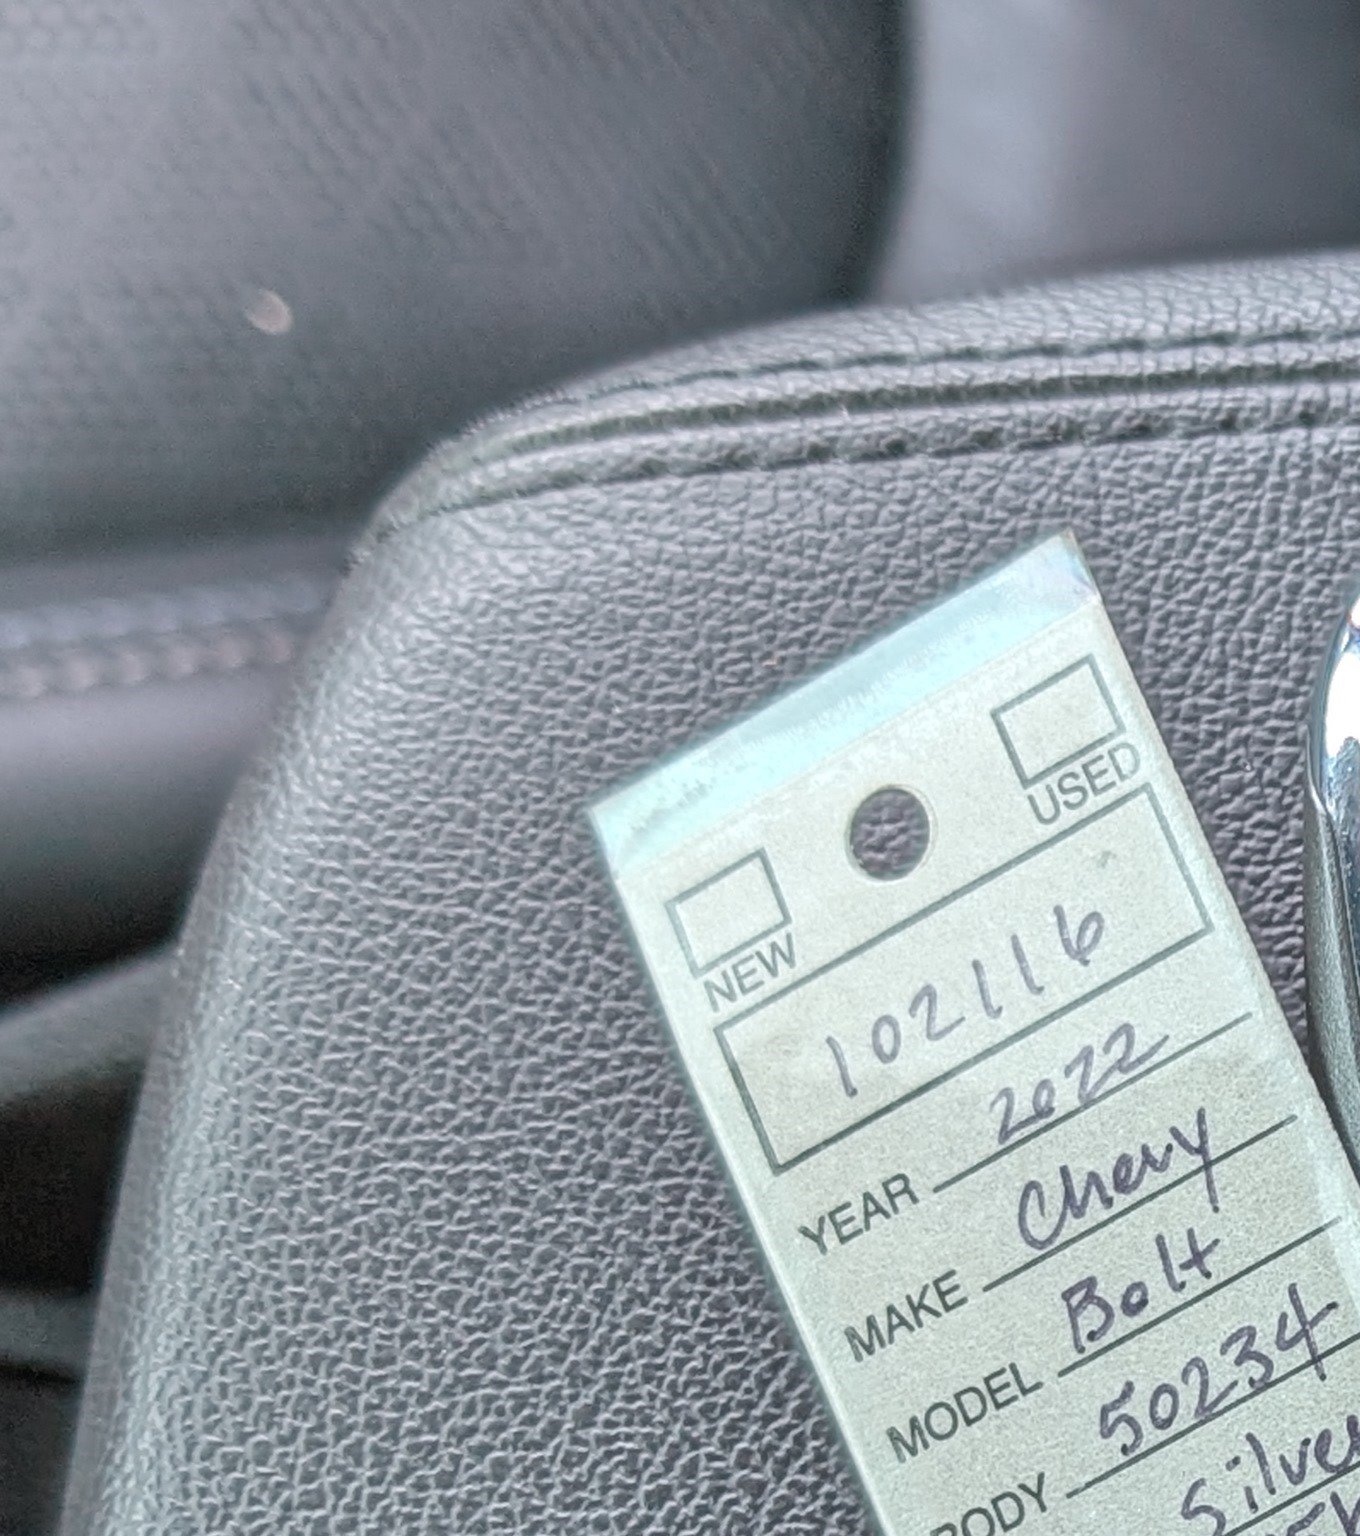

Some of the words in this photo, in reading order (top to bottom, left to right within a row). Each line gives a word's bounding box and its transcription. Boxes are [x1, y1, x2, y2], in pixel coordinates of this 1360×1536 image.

[1027, 741, 1142, 825] USED
[703, 933, 797, 1012] NEW
[825, 904, 1105, 1098] 102116
[990, 1023, 1170, 1144] 2022
[801, 1172, 920, 1256] YEAR
[1017, 1107, 1220, 1251] Chevy
[843, 1269, 970, 1362] MAKE
[1062, 1227, 1220, 1353] Bolt
[886, 1362, 1044, 1463] MODEL
[1097, 1281, 1339, 1457] 50234
